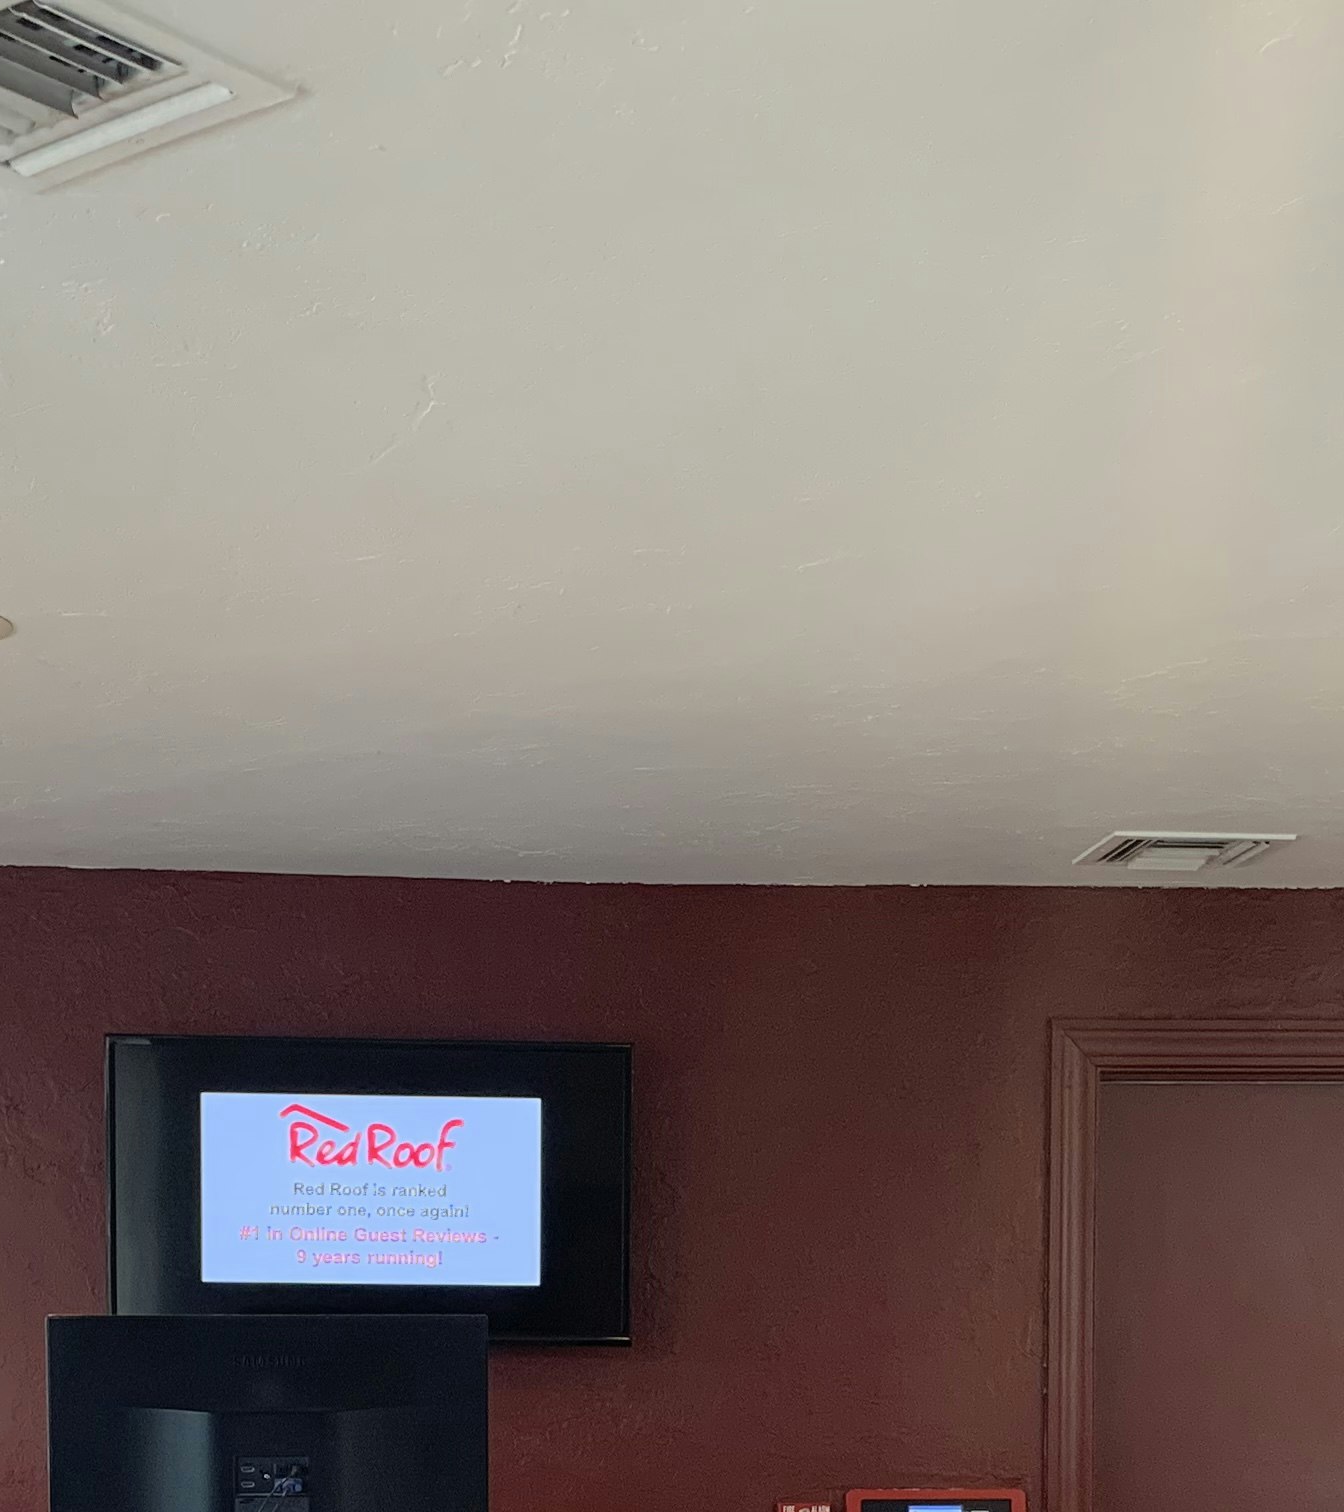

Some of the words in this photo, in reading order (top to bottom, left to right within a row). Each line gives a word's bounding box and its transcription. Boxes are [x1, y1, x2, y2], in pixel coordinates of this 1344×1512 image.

[289, 1121, 362, 1168] Red
[367, 1119, 465, 1173] Roof
[293, 1182, 325, 1196] Red
[330, 1182, 369, 1197] Roof
[373, 1183, 386, 1197] is
[391, 1183, 447, 1198] ranked
[270, 1202, 332, 1216] number
[336, 1205, 371, 1219] one,
[376, 1205, 415, 1217] once
[420, 1204, 469, 1220] again!
[240, 1225, 259, 1241] #1
[267, 1226, 283, 1241] in
[290, 1226, 348, 1242] Online
[354, 1227, 407, 1242] Guest
[412, 1228, 487, 1243] Reviews
[296, 1249, 307, 1264] 9
[312, 1251, 361, 1267] years
[367, 1250, 443, 1269] running!
